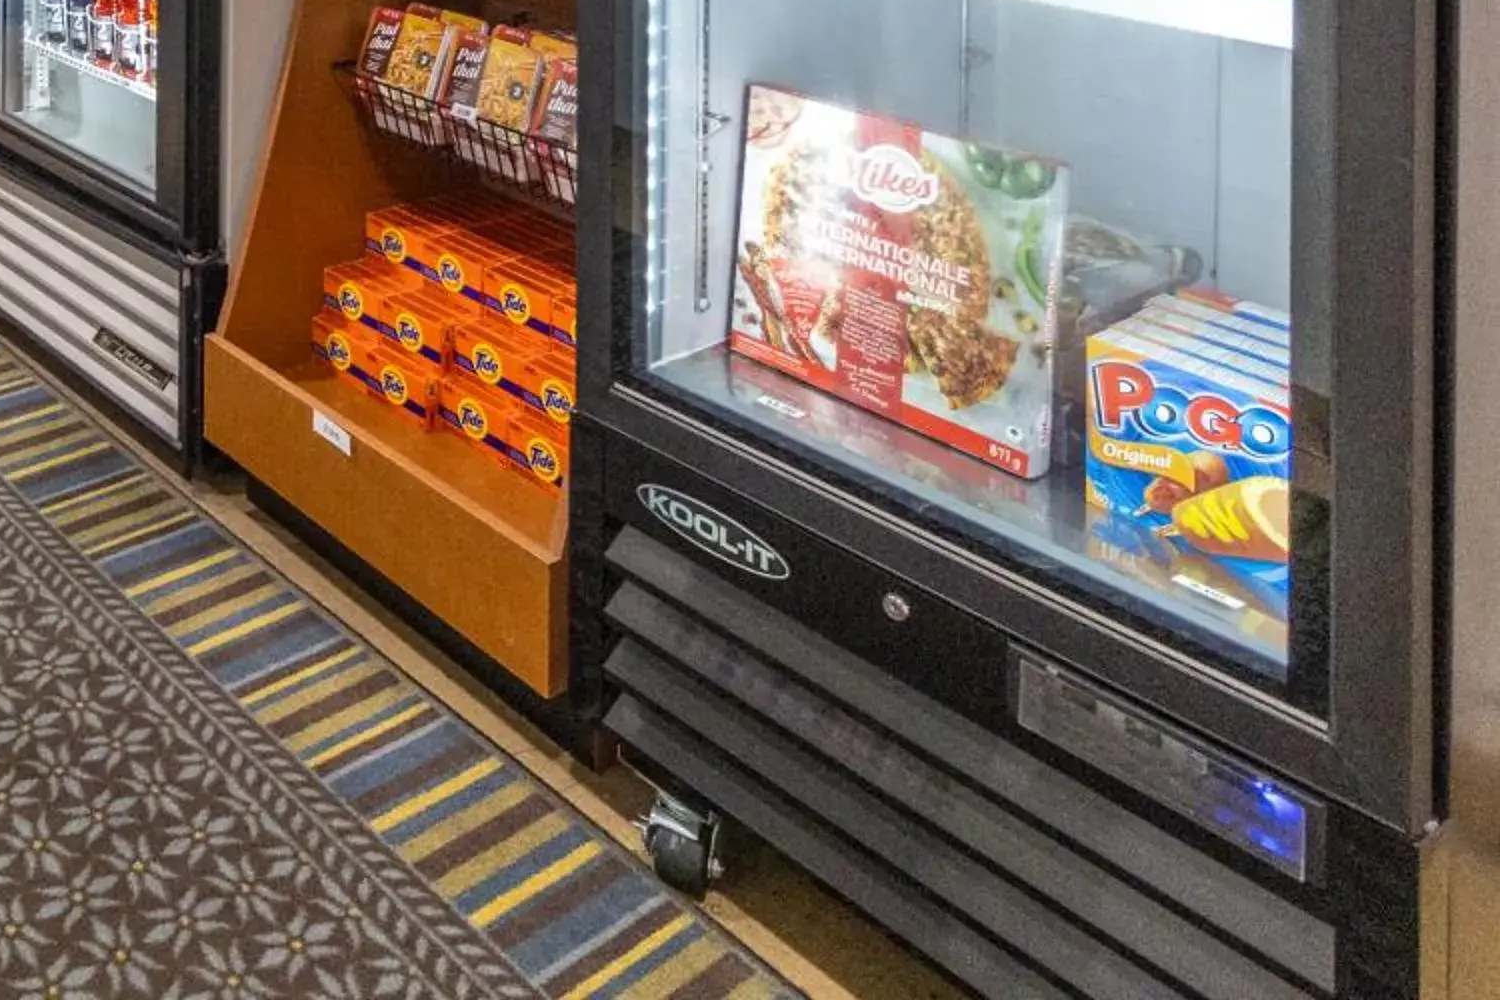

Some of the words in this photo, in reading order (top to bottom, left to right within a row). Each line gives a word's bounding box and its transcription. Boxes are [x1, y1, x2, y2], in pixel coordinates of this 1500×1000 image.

[502, 293, 527, 313] Tide
[398, 322, 419, 341] Tide
[475, 352, 499, 372] Tide
[382, 375, 404, 395] Tide
[544, 388, 571, 410] Tide
[1092, 361, 1290, 458] POGO
[461, 407, 484, 429] Tide
[530, 447, 554, 469] Tide
[1102, 442, 1173, 469] Original
